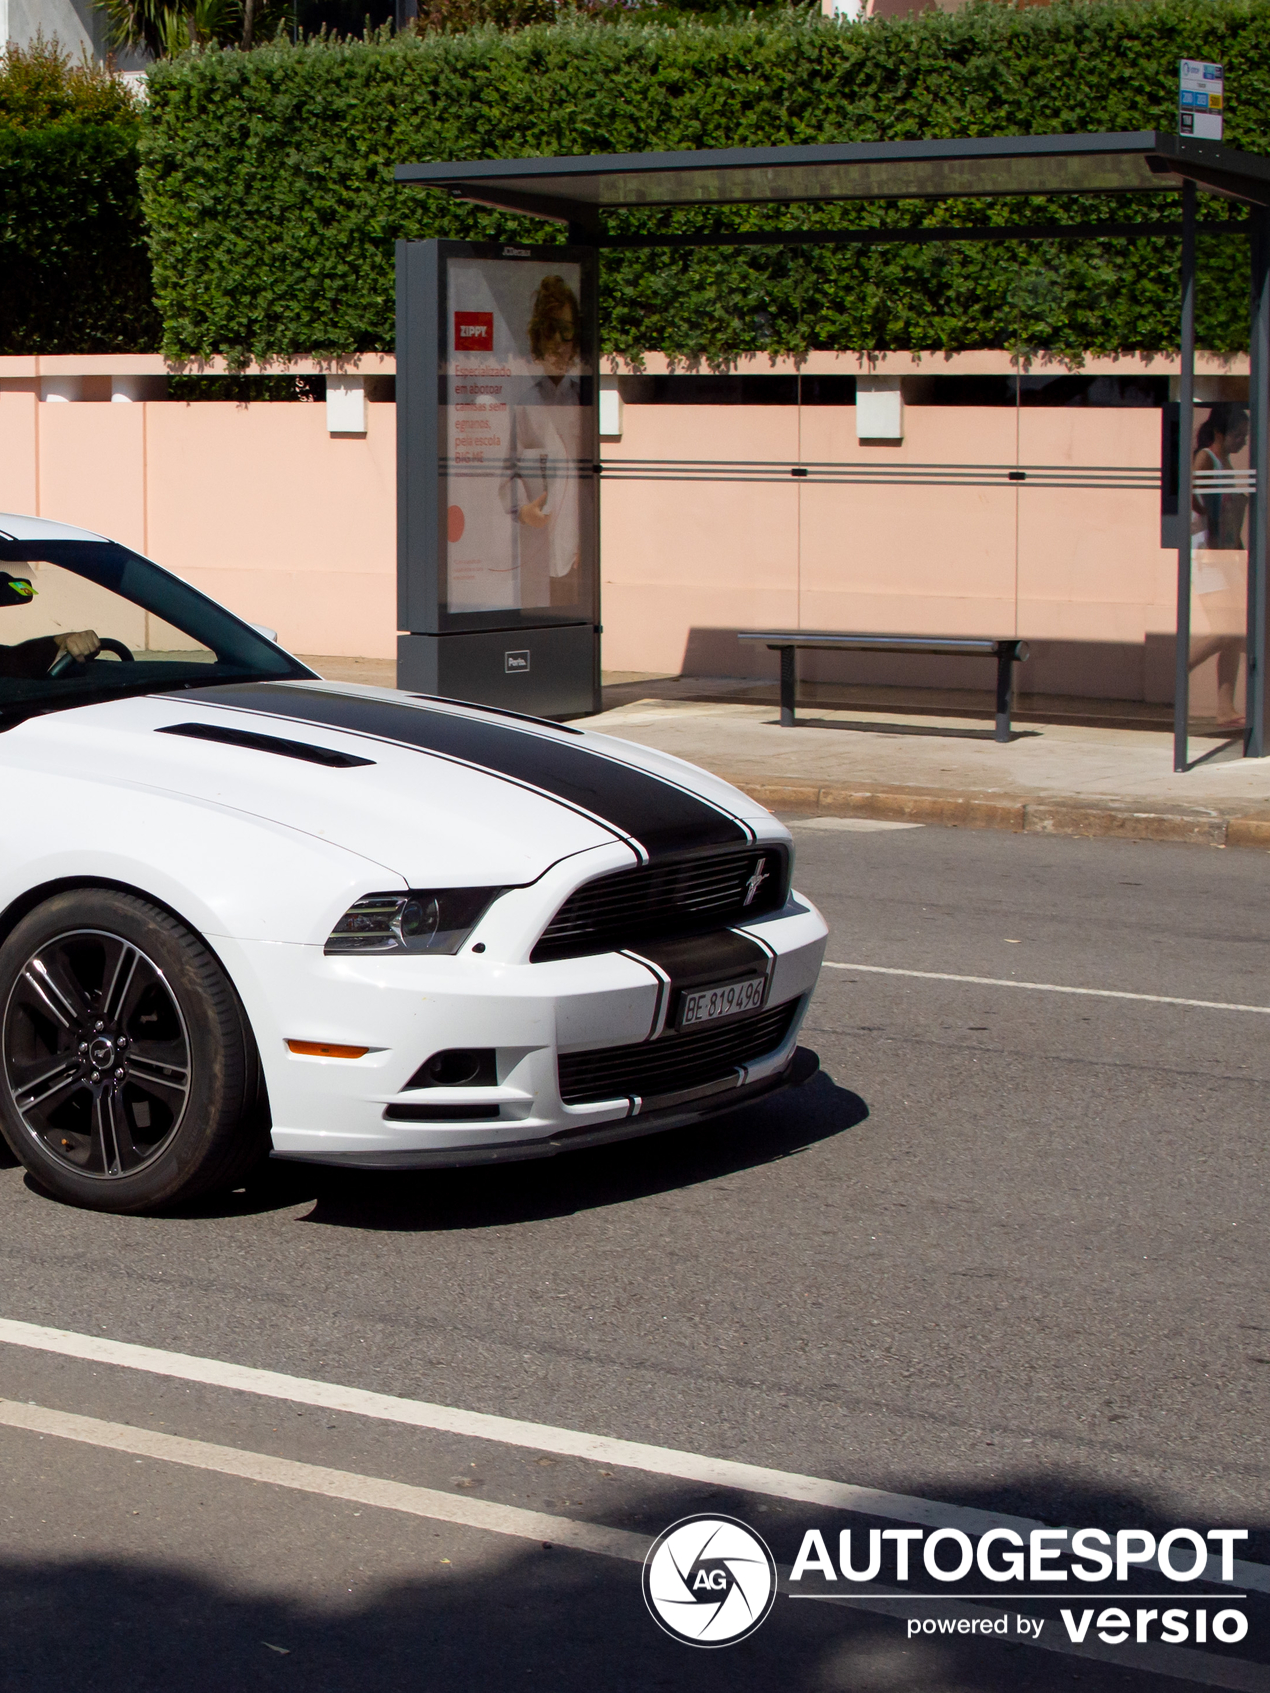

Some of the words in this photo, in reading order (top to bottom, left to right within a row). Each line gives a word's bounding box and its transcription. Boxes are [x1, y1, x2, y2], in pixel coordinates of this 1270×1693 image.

[460, 325, 487, 338] ZIPPY
[454, 364, 512, 379] Especializado
[454, 385, 468, 395] em
[469, 382, 503, 395] abotoar
[454, 401, 487, 412] camisas
[488, 402, 507, 412] sem
[454, 435, 474, 450] pela
[474, 434, 501, 446] escola
[454, 451, 470, 464] BIG
